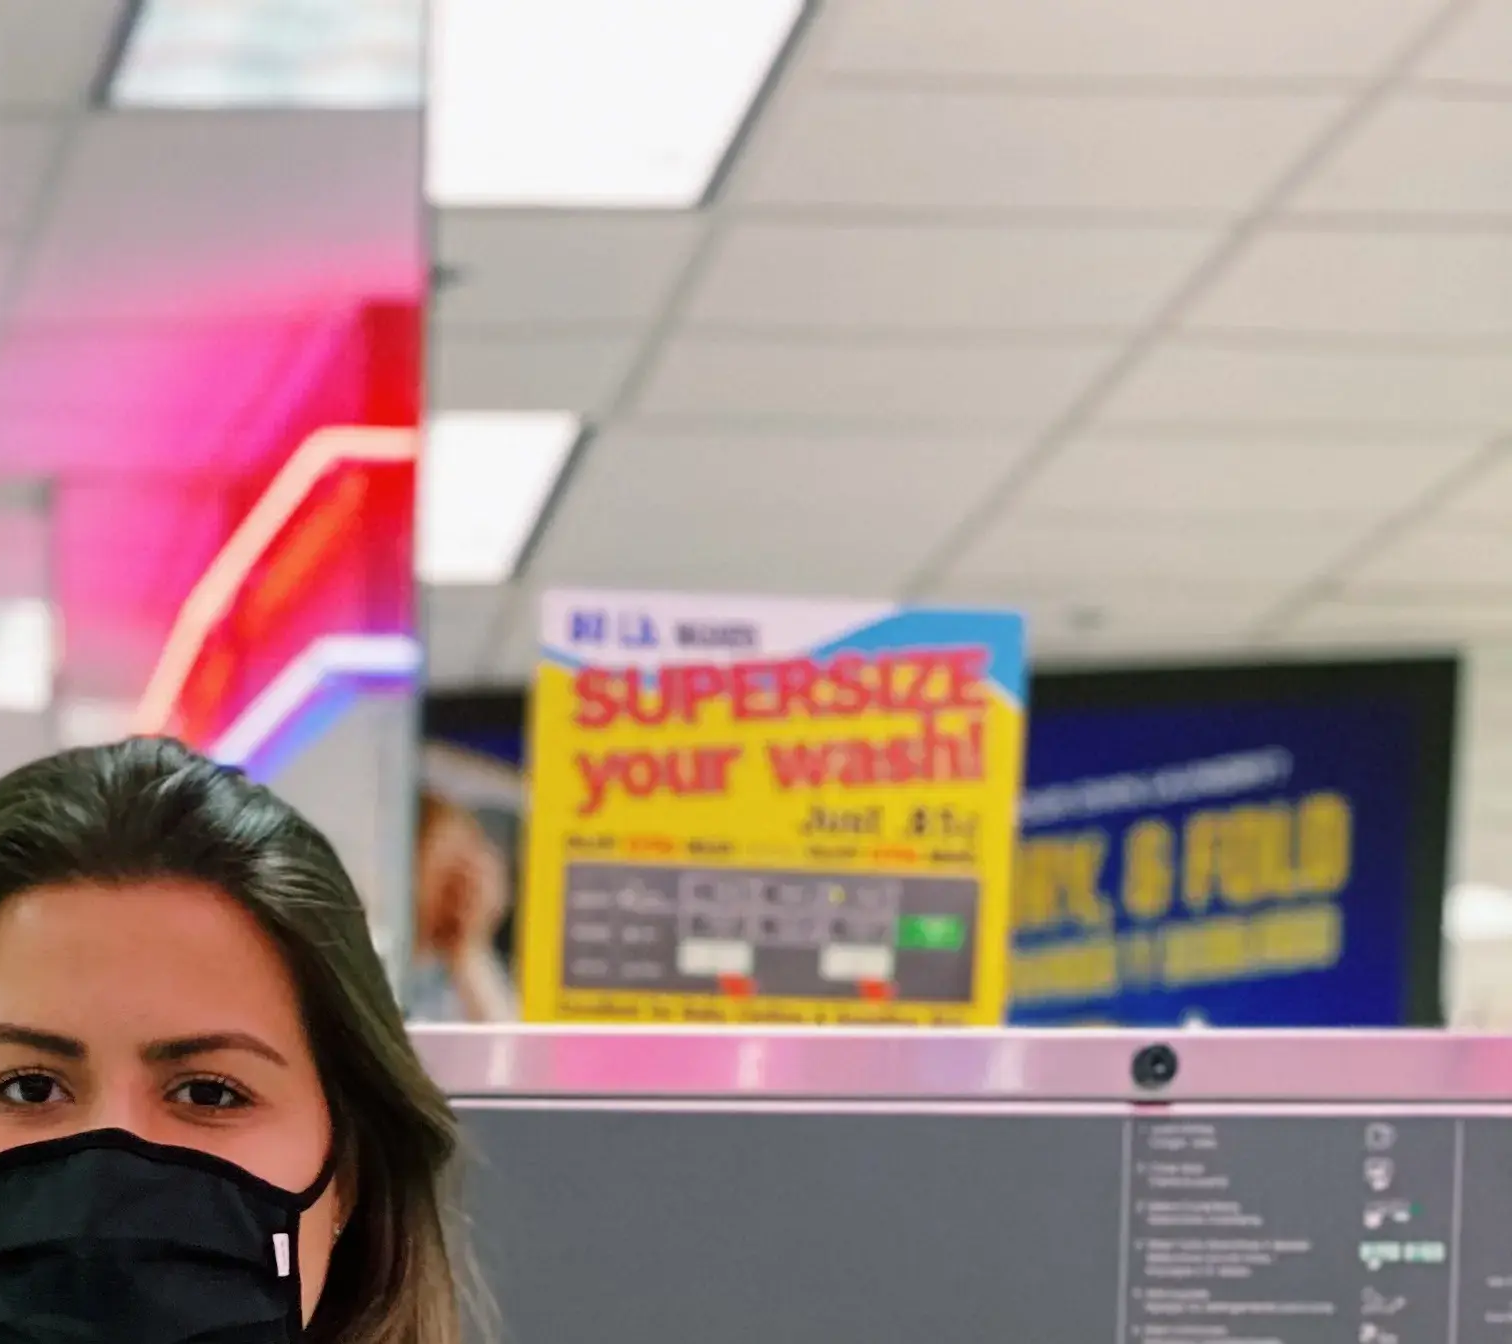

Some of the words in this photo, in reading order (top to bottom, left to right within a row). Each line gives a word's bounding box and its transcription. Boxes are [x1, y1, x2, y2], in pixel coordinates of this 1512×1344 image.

[573, 645, 992, 730] SUPERSIZE
[575, 743, 742, 817] your
[767, 709, 984, 788] wash!
